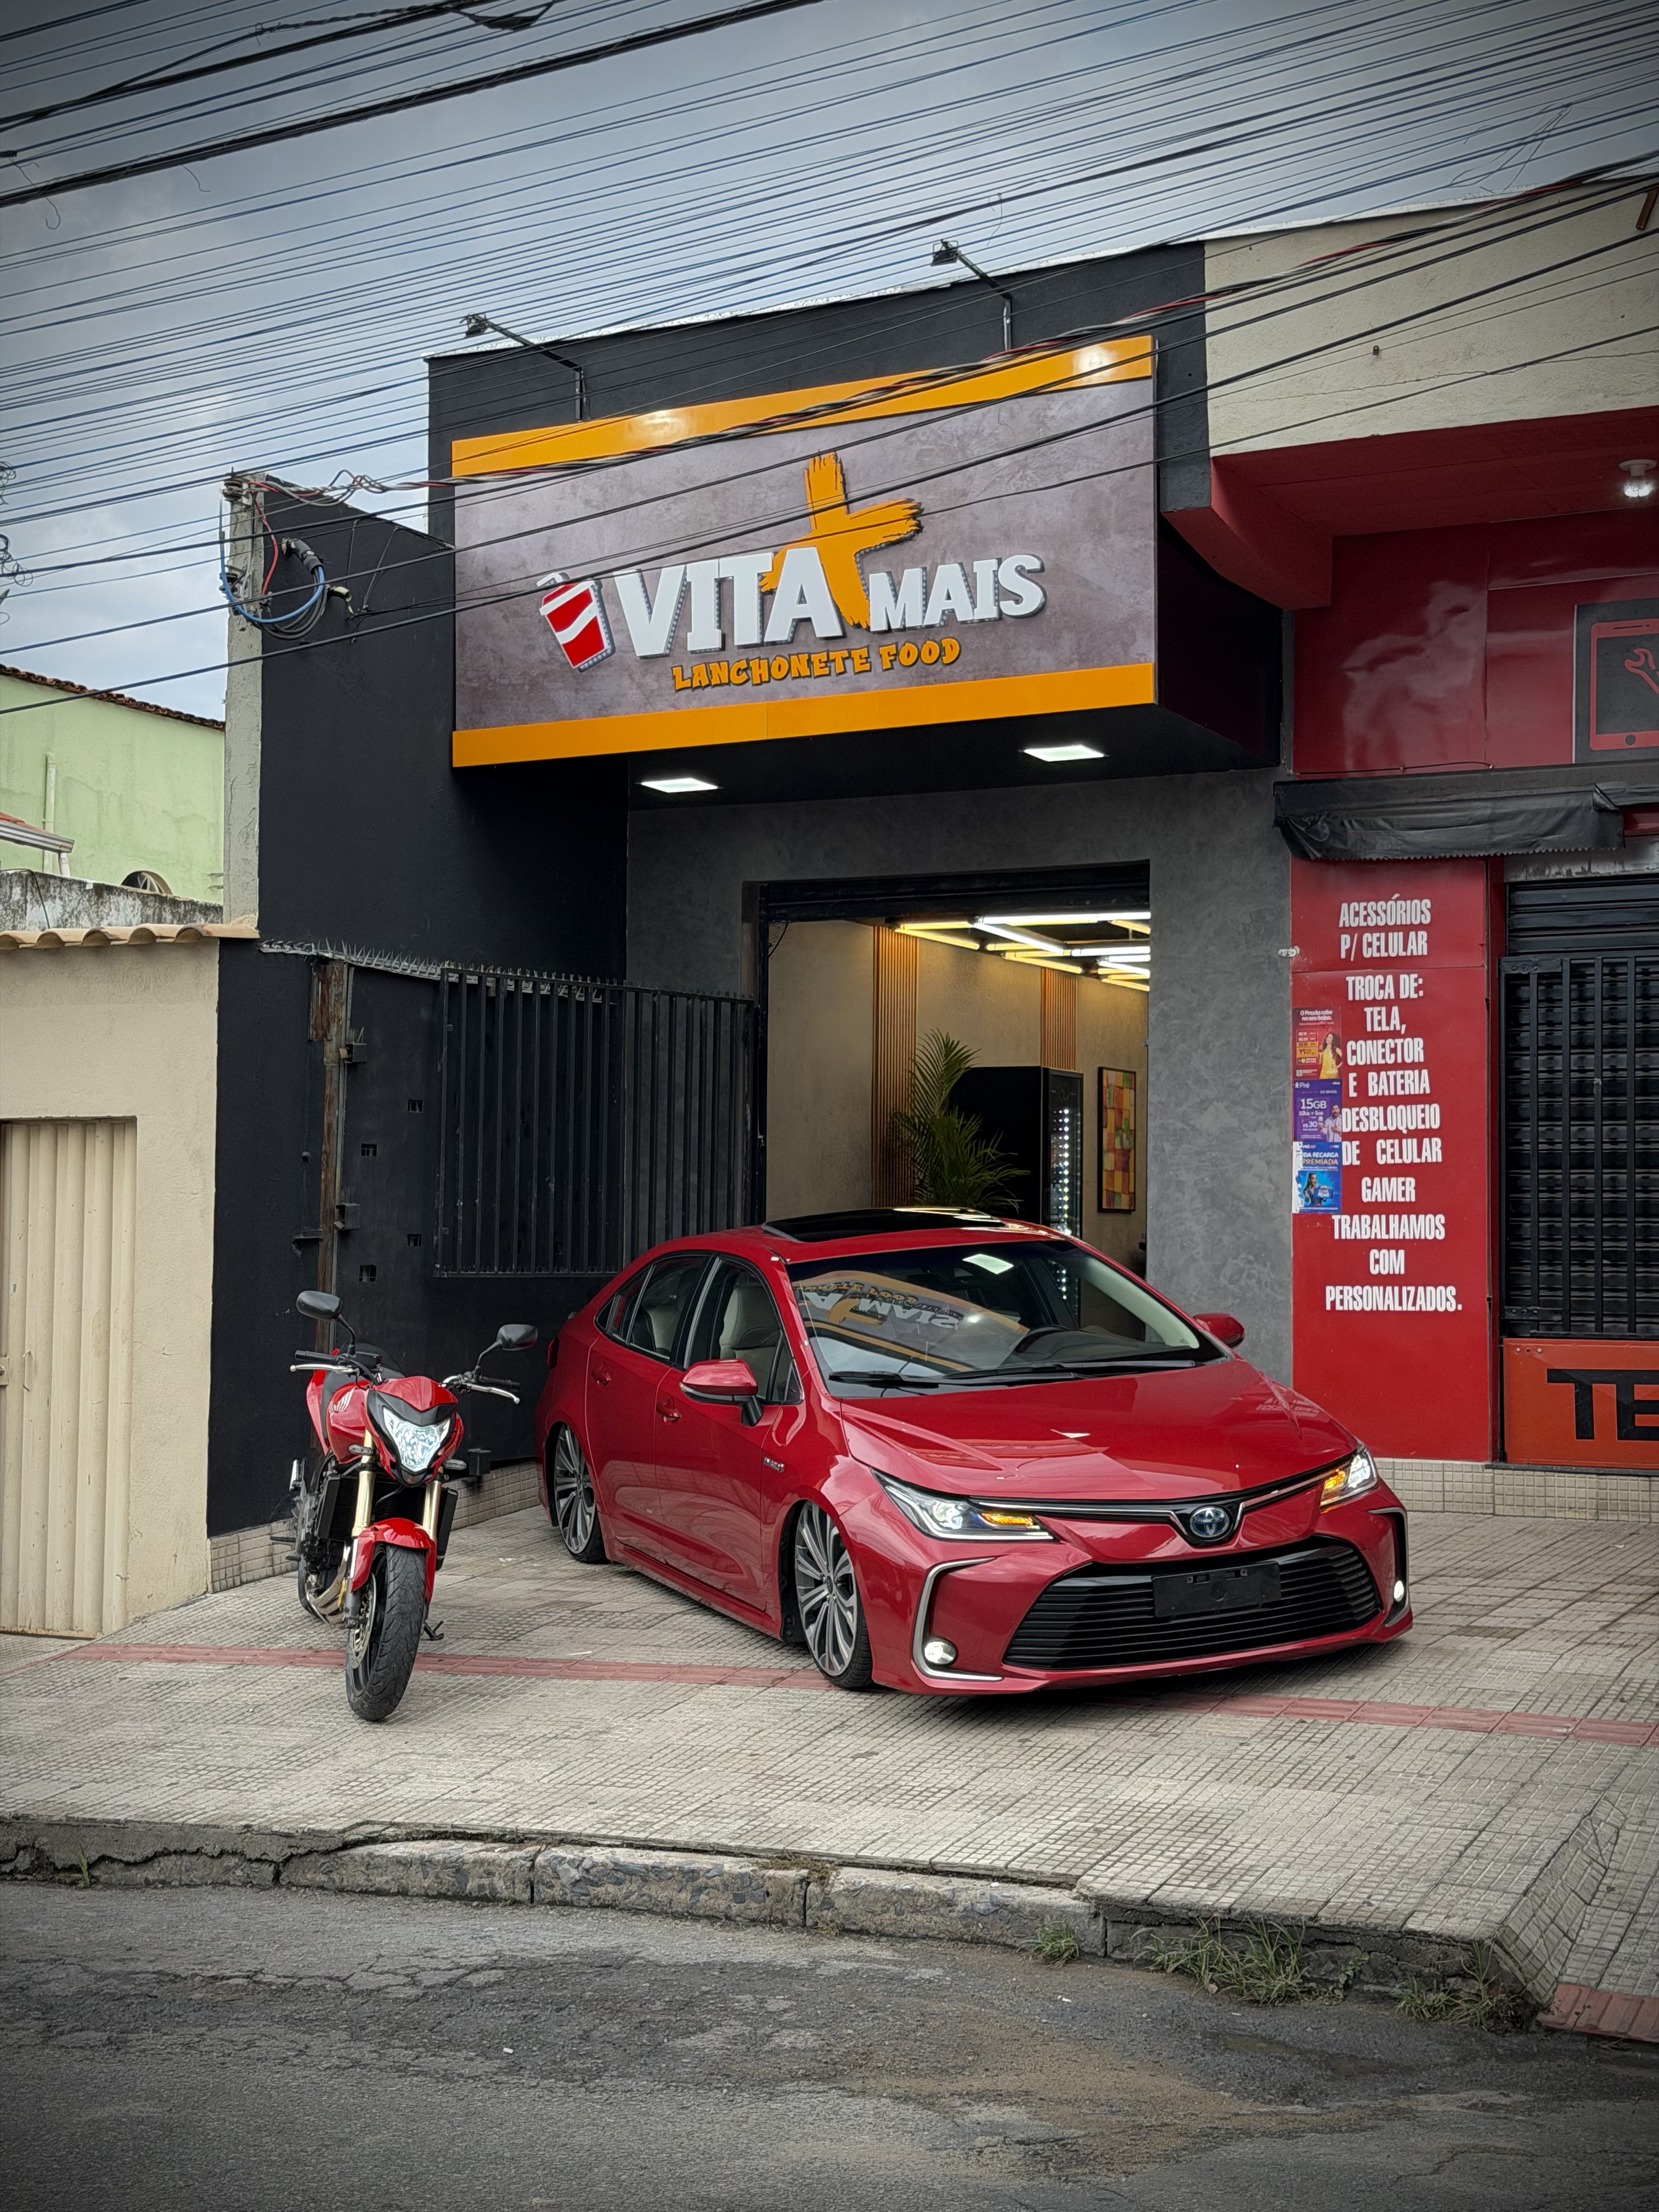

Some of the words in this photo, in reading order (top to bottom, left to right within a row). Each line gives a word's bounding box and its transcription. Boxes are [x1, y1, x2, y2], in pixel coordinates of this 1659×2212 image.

[613, 546, 843, 657] VITA
[869, 554, 1045, 631] MAIS
[672, 647, 871, 691] LANCHONETE
[879, 637, 960, 670] FOOD
[1339, 893, 1431, 927] ACESSÓRIOS
[1341, 933, 1358, 961] P/
[1362, 931, 1427, 958] CELULAR
[1346, 975, 1395, 1001] TROCA
[1400, 974, 1424, 999] DE:
[1364, 1006, 1406, 1034] TELA,
[1347, 1038, 1424, 1065] CONECTOR
[1348, 1073, 1357, 1097] E
[1368, 1069, 1430, 1096] BATERIA
[1300, 1098, 1327, 1109] 15GB
[1341, 1104, 1440, 1134] DESBLOQUEIO
[1342, 1141, 1360, 1165] DE
[1376, 1137, 1442, 1164] CELULAR
[1362, 1177, 1415, 1202] GAMER
[1331, 1214, 1445, 1240] TRABALHAMOS
[1369, 1249, 1405, 1274] COM
[1325, 1285, 1463, 1311] PERSONALIZADOS.
